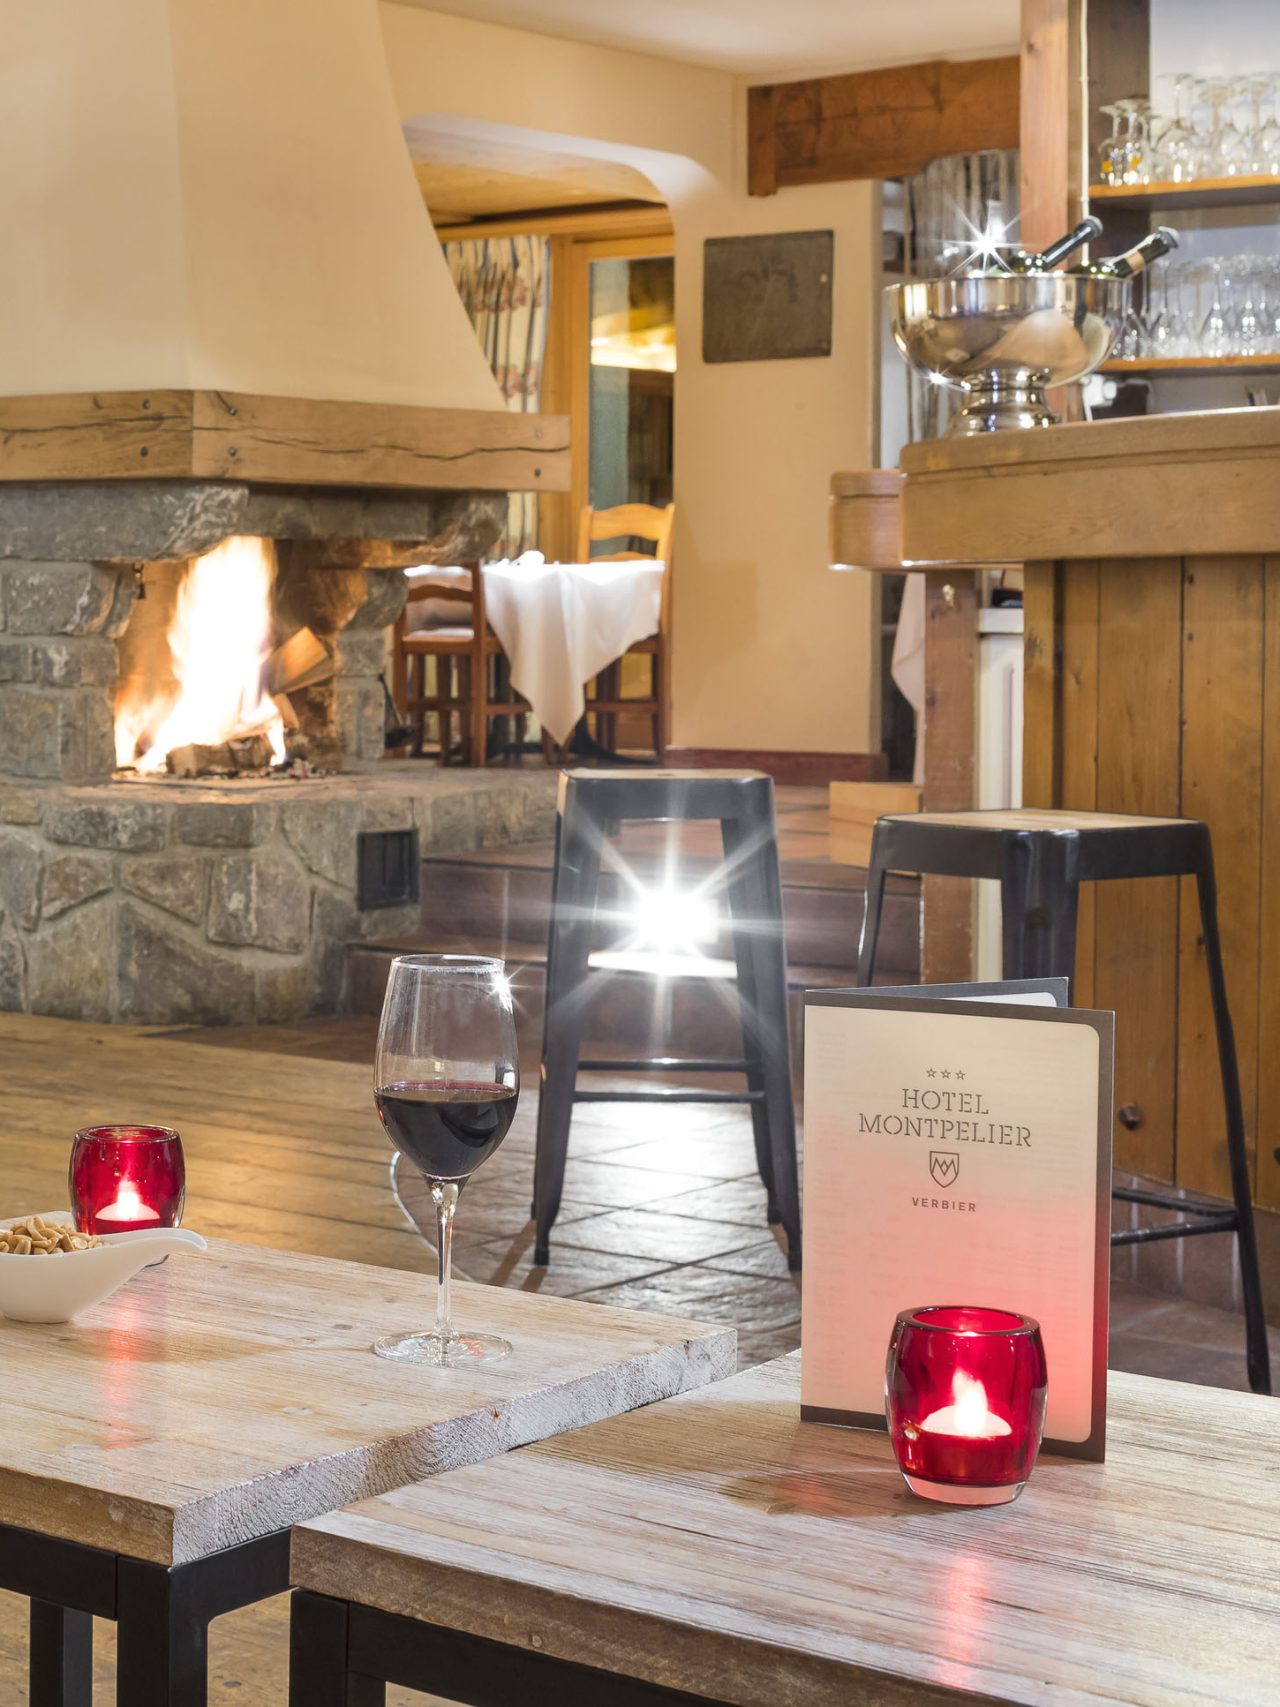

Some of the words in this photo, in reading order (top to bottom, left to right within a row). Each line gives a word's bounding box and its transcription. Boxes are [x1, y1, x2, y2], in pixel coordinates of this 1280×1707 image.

[902, 1088, 989, 1115] HOTEL
[858, 1113, 1032, 1147] MONTPELIER
[912, 1197, 976, 1212] VERBIER
